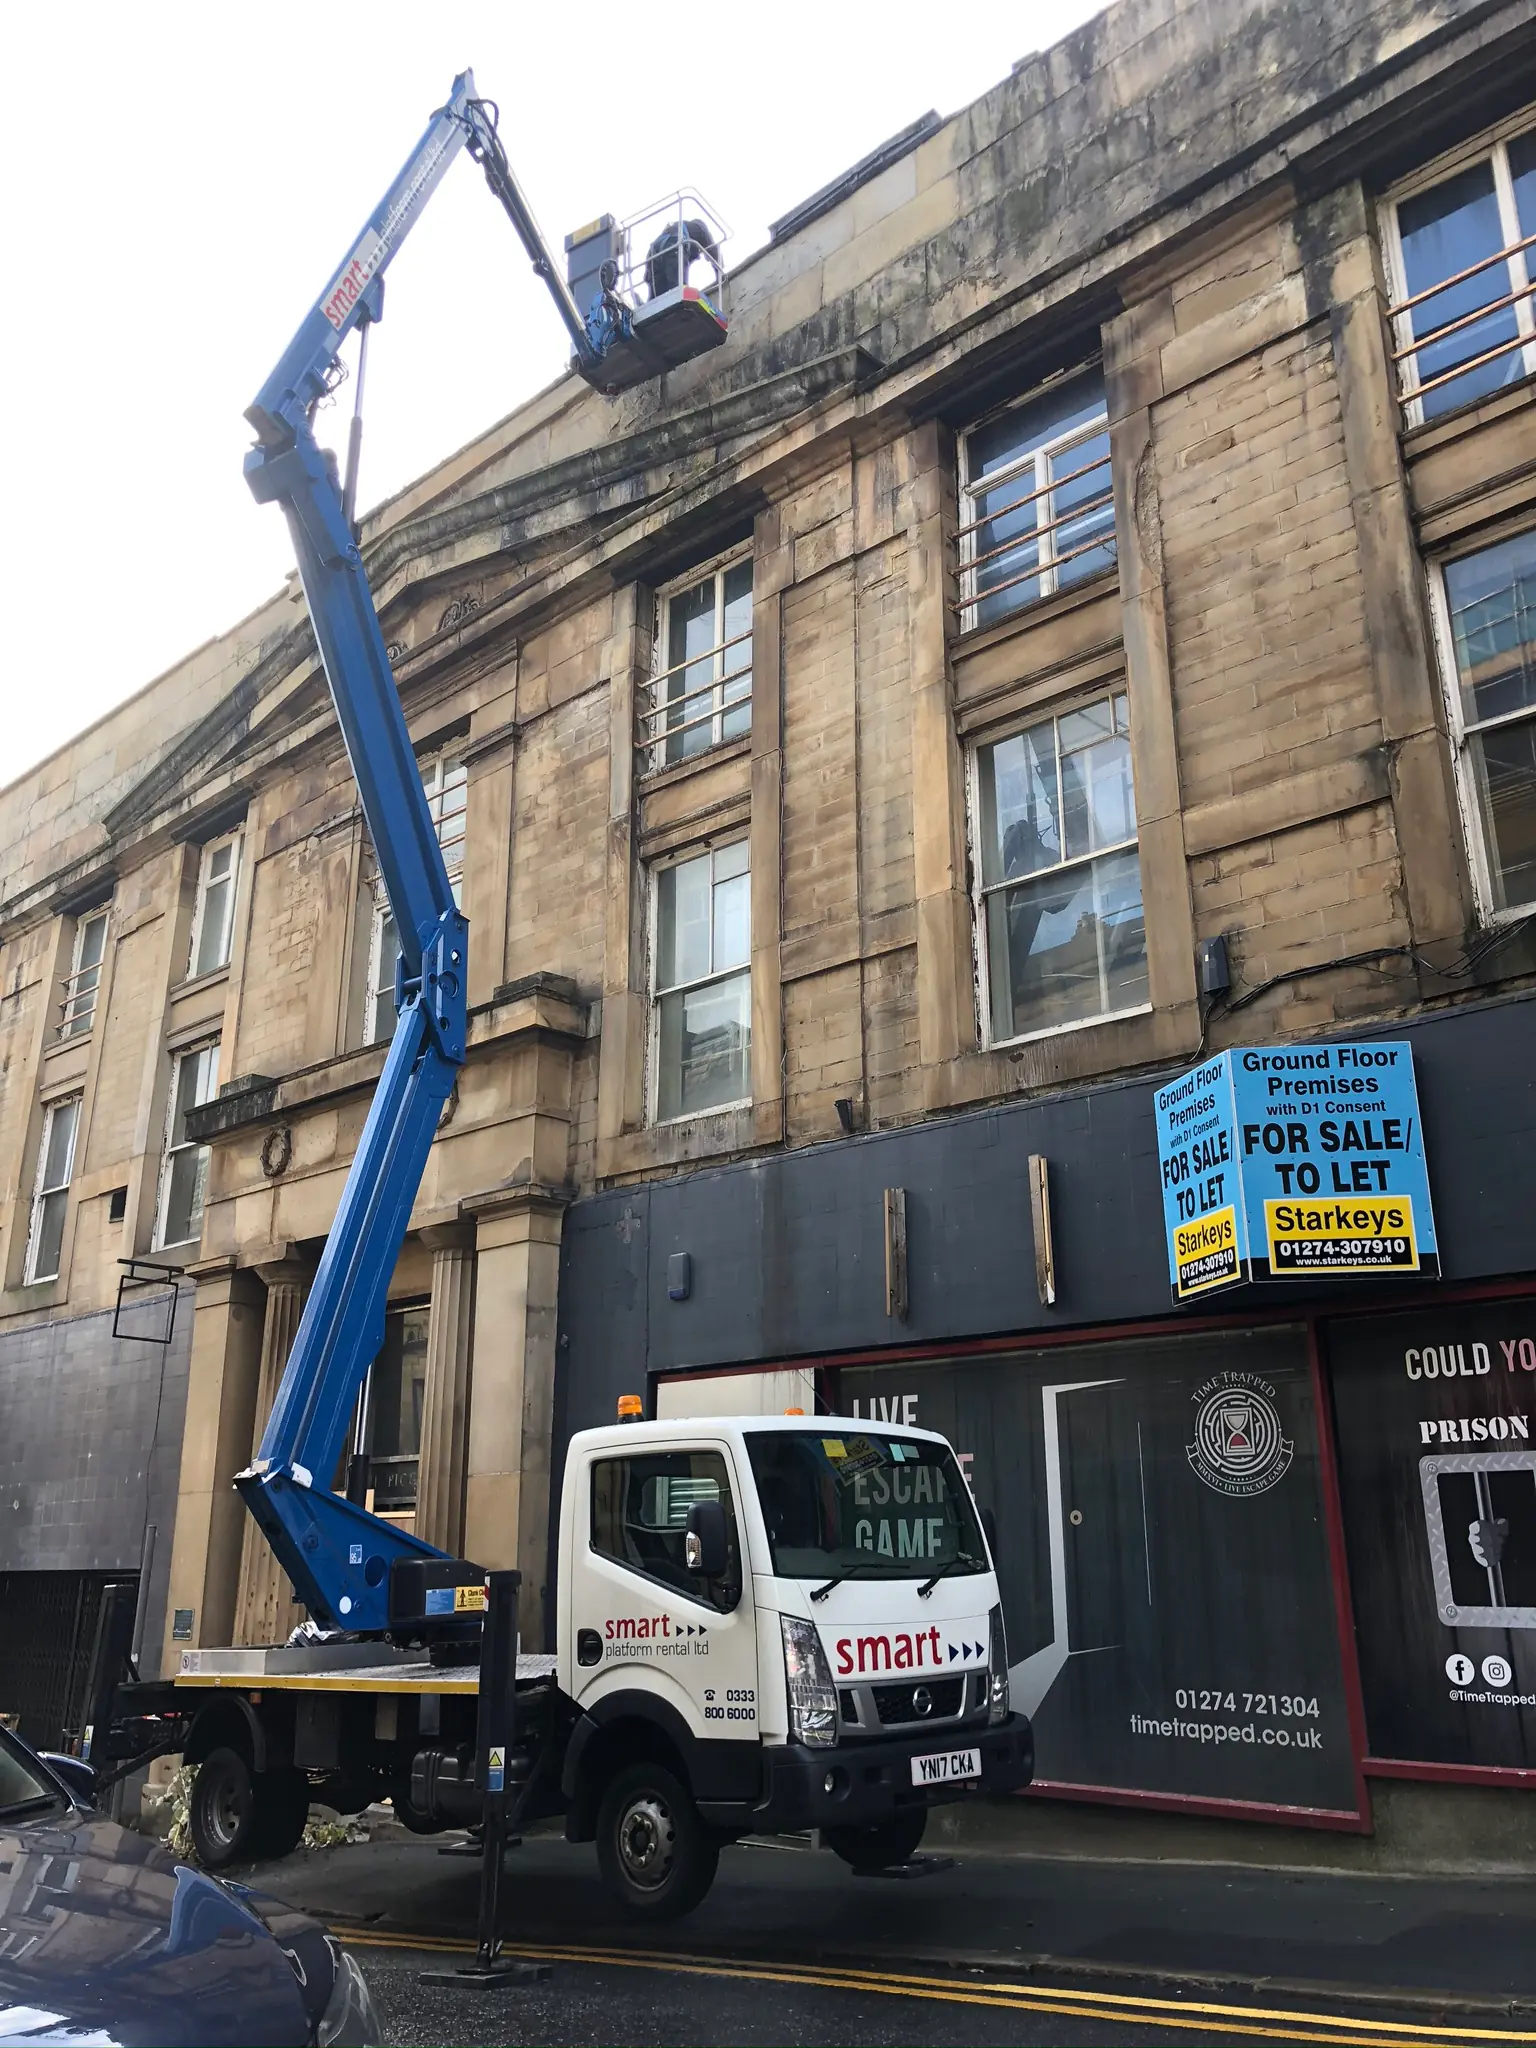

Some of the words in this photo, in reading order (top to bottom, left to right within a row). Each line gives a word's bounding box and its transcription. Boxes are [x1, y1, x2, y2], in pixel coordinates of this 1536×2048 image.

[325, 259, 369, 328] smart
[379, 190, 416, 249] platform
[410, 152, 437, 196] rental
[1243, 1050, 1330, 1072] Ground
[1338, 1048, 1398, 1068] Floor
[1159, 1076, 1194, 1111] Ground
[1196, 1062, 1223, 1091] Floor
[1268, 1075, 1379, 1096] Premises
[1169, 1094, 1215, 1130] Premises
[1266, 1103, 1297, 1116] with
[1302, 1102, 1319, 1115] D1
[1325, 1100, 1386, 1114] Consent
[1170, 1133, 1183, 1149] with
[1183, 1129, 1192, 1142] D1
[1193, 1114, 1220, 1137] Consent
[1243, 1122, 1309, 1155] FOR
[1319, 1117, 1412, 1153] SALE/
[1163, 1151, 1190, 1189] FOR
[1192, 1126, 1233, 1175] SALE/
[1275, 1163, 1320, 1194] TO
[1331, 1160, 1391, 1193] LET
[1176, 1187, 1195, 1221] TO
[1199, 1173, 1224, 1213] LET
[1275, 1205, 1404, 1235] Starkeys
[1178, 1220, 1232, 1256] Starkeys
[1280, 1239, 1405, 1256] 01274-307910
[1181, 1249, 1234, 1279] 01274-307910
[1296, 1255, 1392, 1267] www.starkeys.co.uk
[1188, 1267, 1228, 1286] www.starkeys.co.uk
[1405, 1342, 1491, 1380] COULD
[1191, 1377, 1220, 1403] TIME
[1220, 1371, 1276, 1398] TRAPPED
[1419, 1415, 1529, 1443] PRISON
[1224, 1483, 1240, 1493] LIVE
[1242, 1477, 1269, 1493] ESCAPE
[1268, 1461, 1286, 1481] GAME
[605, 1613, 670, 1639] smart
[606, 1642, 652, 1660] platform
[656, 1641, 690, 1656] rental
[694, 1640, 709, 1655] ltd
[836, 1625, 943, 1675] smart
[727, 1690, 755, 1702] 0333
[1175, 1688, 1236, 1712] 01274
[1242, 1692, 1320, 1718] 721304
[1449, 1689, 1536, 1706] @TimeTrapped
[705, 1707, 724, 1719] 800
[727, 1708, 755, 1720] 6000
[1130, 1714, 1323, 1749] timetrapped.co.uk
[920, 1756, 947, 1780] YN17
[951, 1753, 974, 1775] CKA
